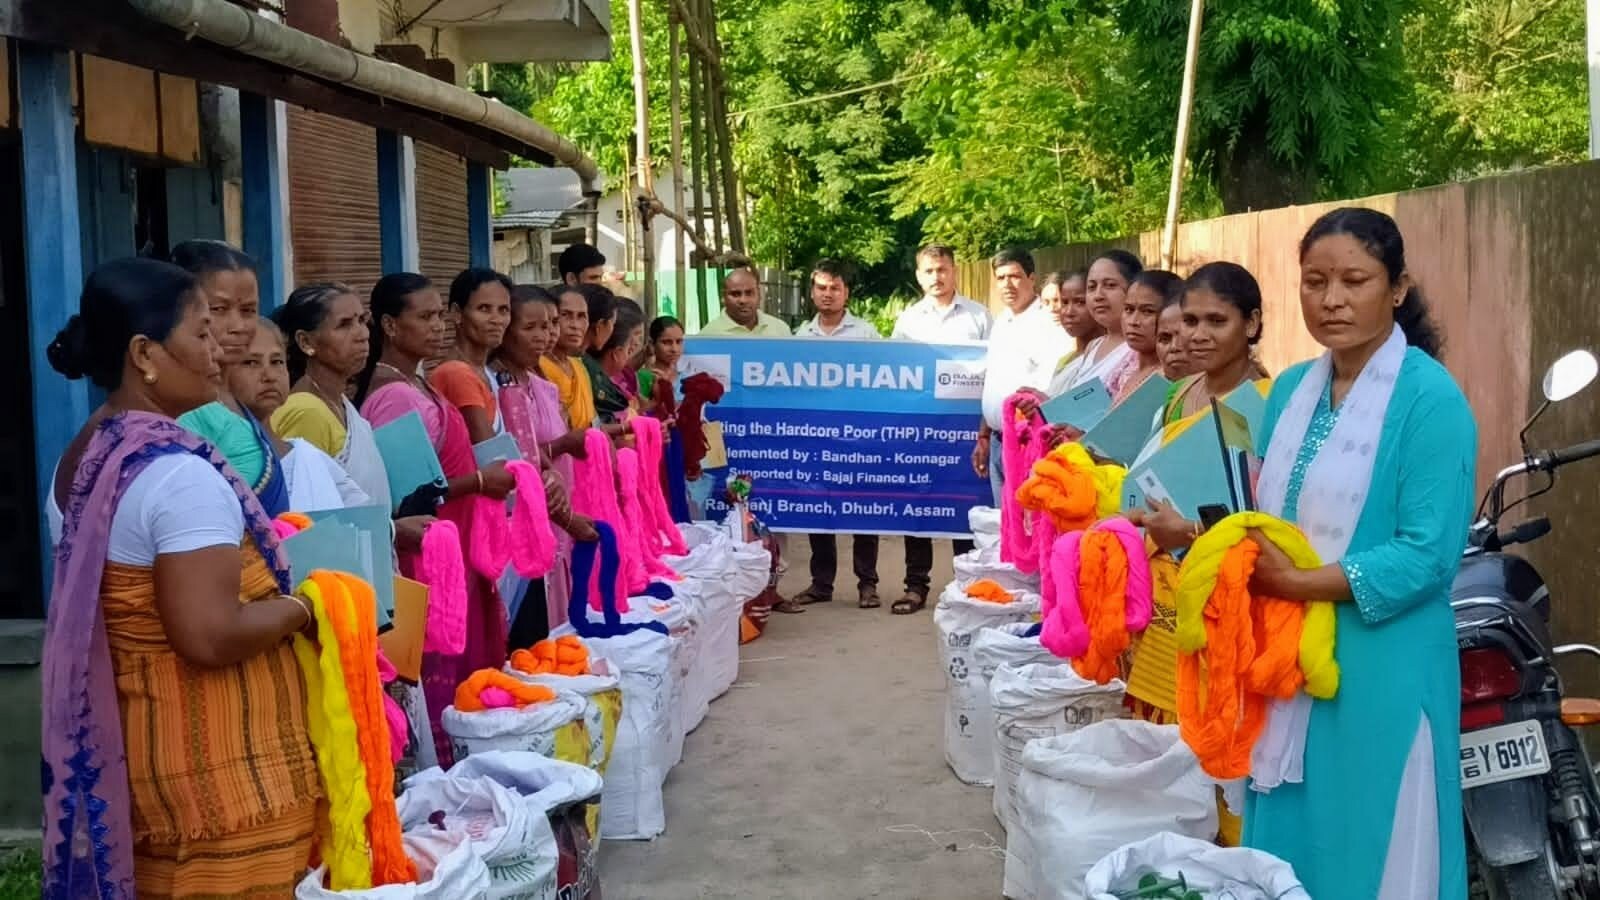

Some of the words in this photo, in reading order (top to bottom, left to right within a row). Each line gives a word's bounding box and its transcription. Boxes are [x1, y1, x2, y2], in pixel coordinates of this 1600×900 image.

[743, 362, 924, 390] BANDHAN
[720, 421, 746, 437] ting
[750, 421, 772, 435] the
[776, 421, 840, 437] Hardcore
[843, 425, 877, 439] Poor
[881, 427, 920, 442] (THP)
[727, 447, 789, 459] lemented
[793, 449, 809, 463] by
[821, 450, 882, 464] Bandhan
[894, 452, 961, 467] Konnagar
[796, 469, 812, 481] by
[823, 470, 853, 484] Bajaj
[856, 472, 906, 484] Finance
[909, 473, 932, 484] Ltd.
[777, 499, 837, 516] Branch,
[841, 501, 898, 517] Dhubri,
[902, 503, 956, 517] Assam
